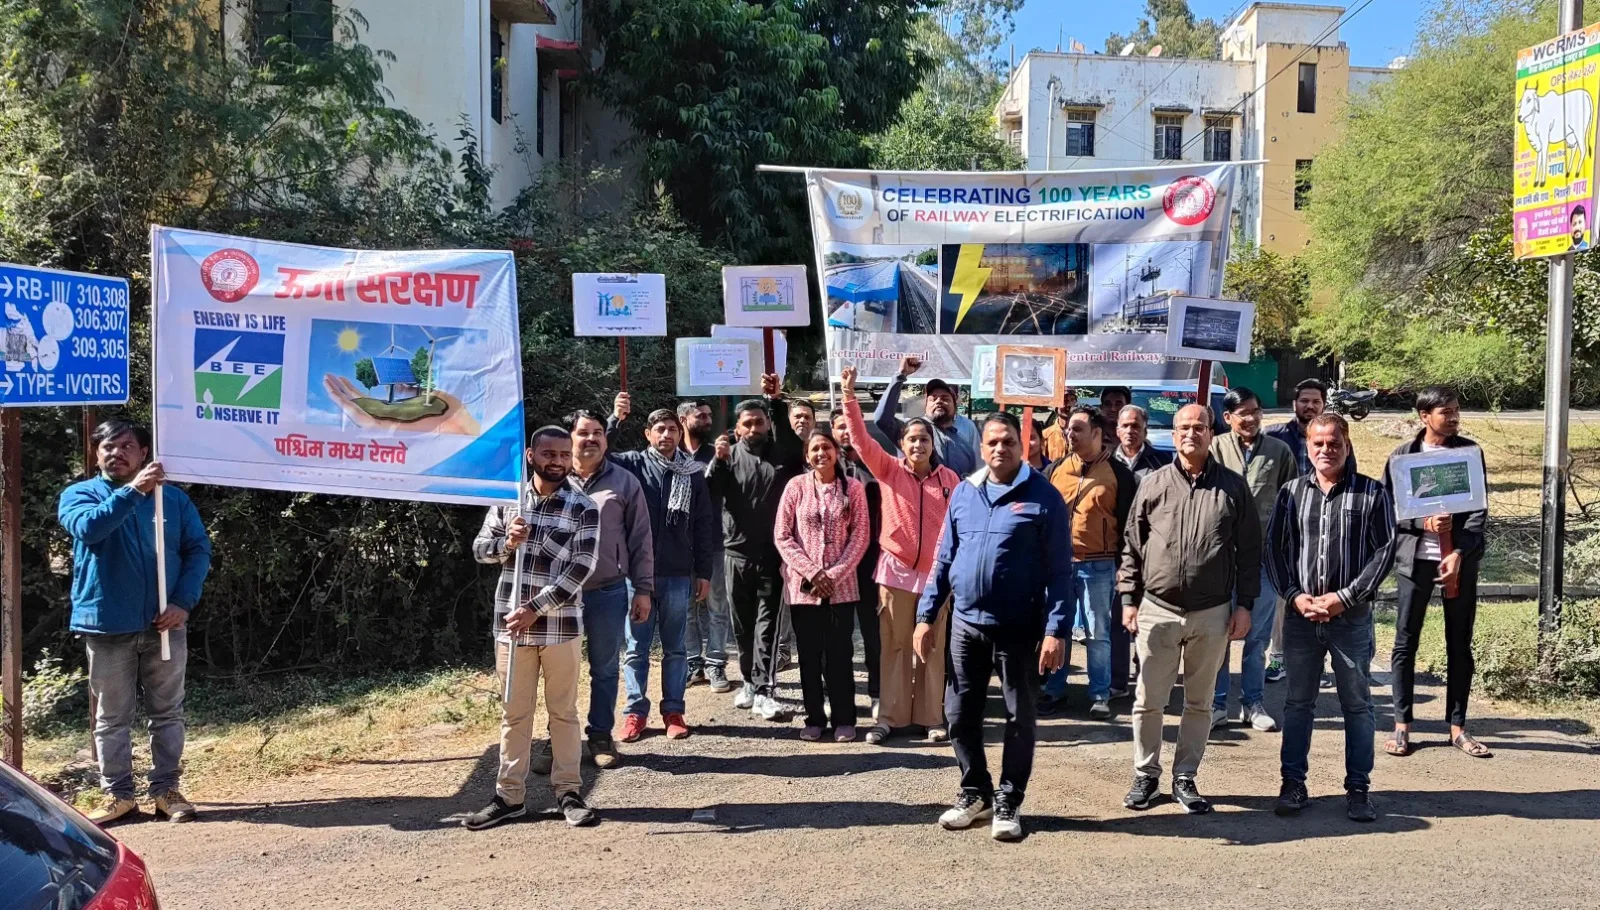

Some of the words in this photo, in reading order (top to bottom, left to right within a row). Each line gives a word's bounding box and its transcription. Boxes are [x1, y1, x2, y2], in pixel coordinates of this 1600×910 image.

[1533, 31, 1586, 61] WCRMS
[1549, 162, 1564, 176] गाय
[882, 187, 1031, 204] CELEBRATING
[1038, 187, 1072, 204] 100
[1079, 184, 1152, 202] YEARS
[1573, 180, 1588, 196] गाय
[887, 209, 909, 222] OF
[914, 210, 989, 222] RAILWAY
[994, 206, 1145, 222] ELECTRIFICATION
[75, 308, 126, 335] 306,307,
[193, 310, 240, 328] ENERGY
[244, 314, 258, 329] IS
[262, 315, 286, 331] LIFE
[829, 348, 876, 359] lectrical
[1066, 350, 1107, 362] entral
[210, 361, 265, 375] BEE
[267, 411, 280, 425] IT
[274, 433, 325, 458] पश्चिम
[327, 440, 366, 461] मध्य
[368, 439, 408, 464] रेलवे
